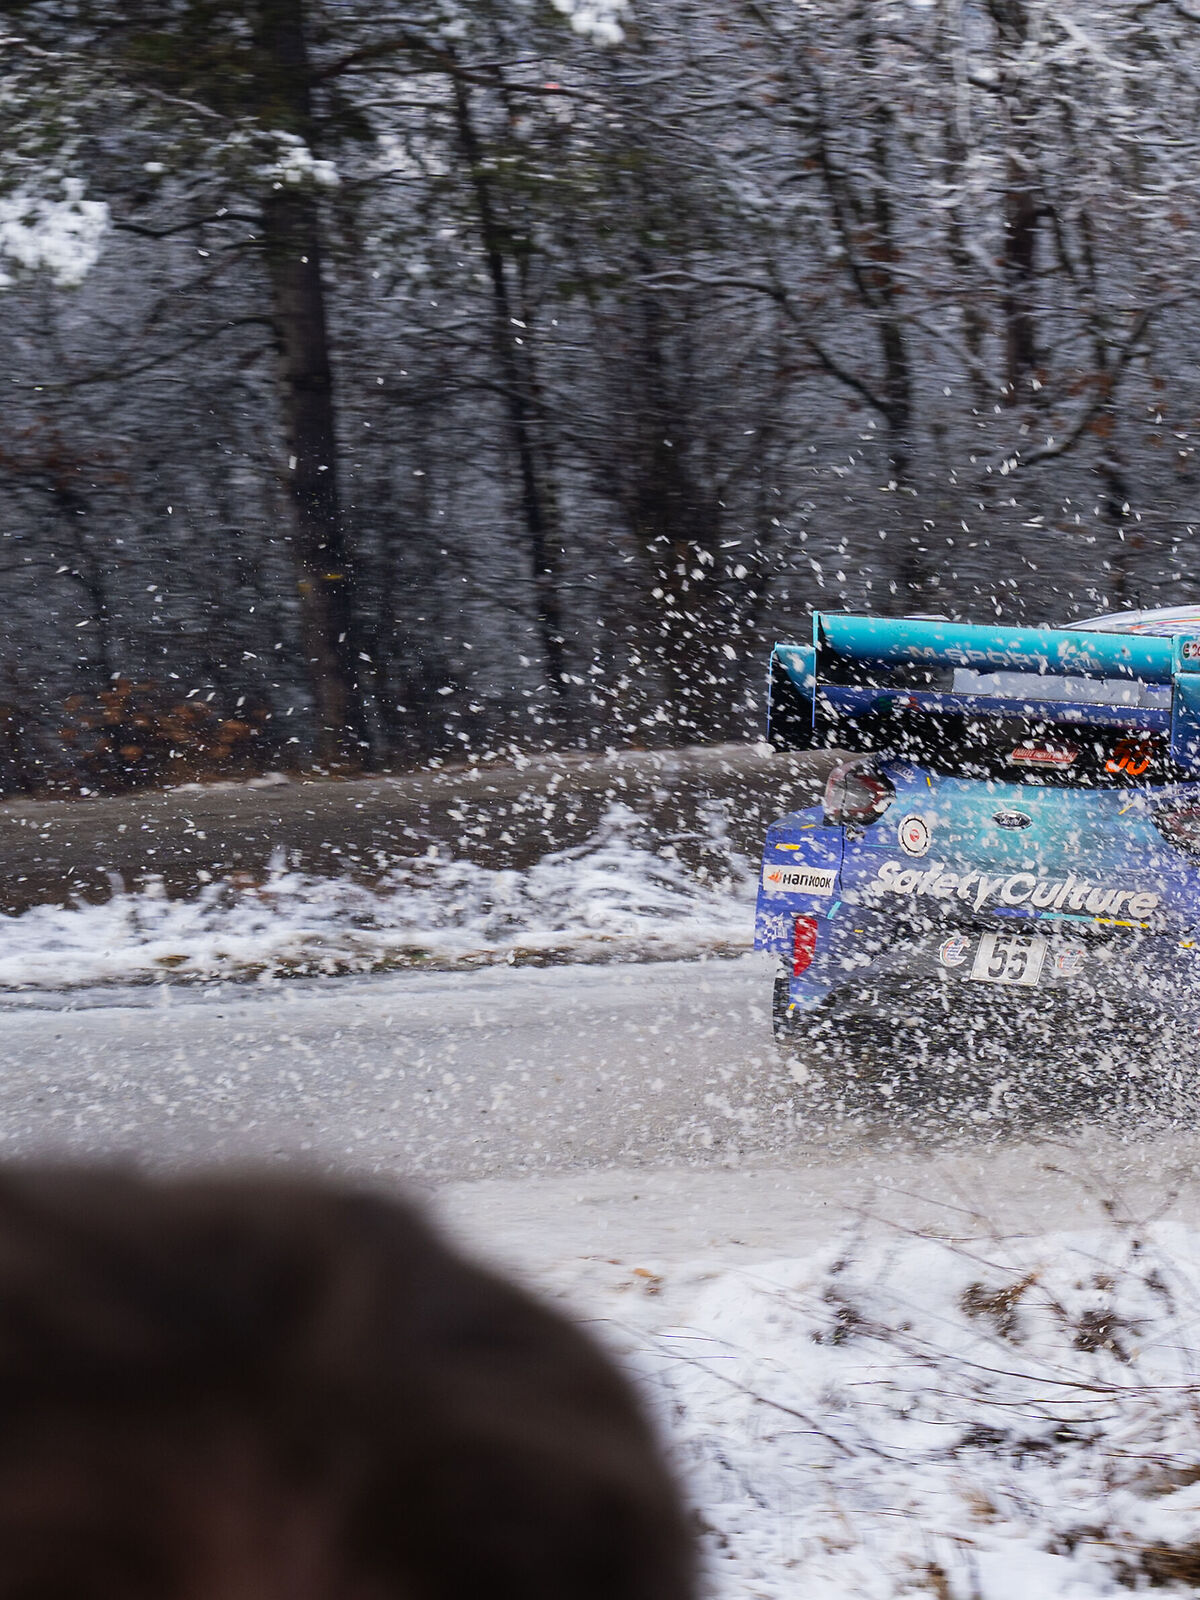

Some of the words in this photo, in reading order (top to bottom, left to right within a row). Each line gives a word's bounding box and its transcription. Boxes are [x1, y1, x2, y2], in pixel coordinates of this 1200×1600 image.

[926, 702, 1049, 719] otorsport
[1057, 710, 1138, 727] Ieland
[871, 860, 1160, 919] SafetyCulture
[987, 935, 1033, 980] 55
